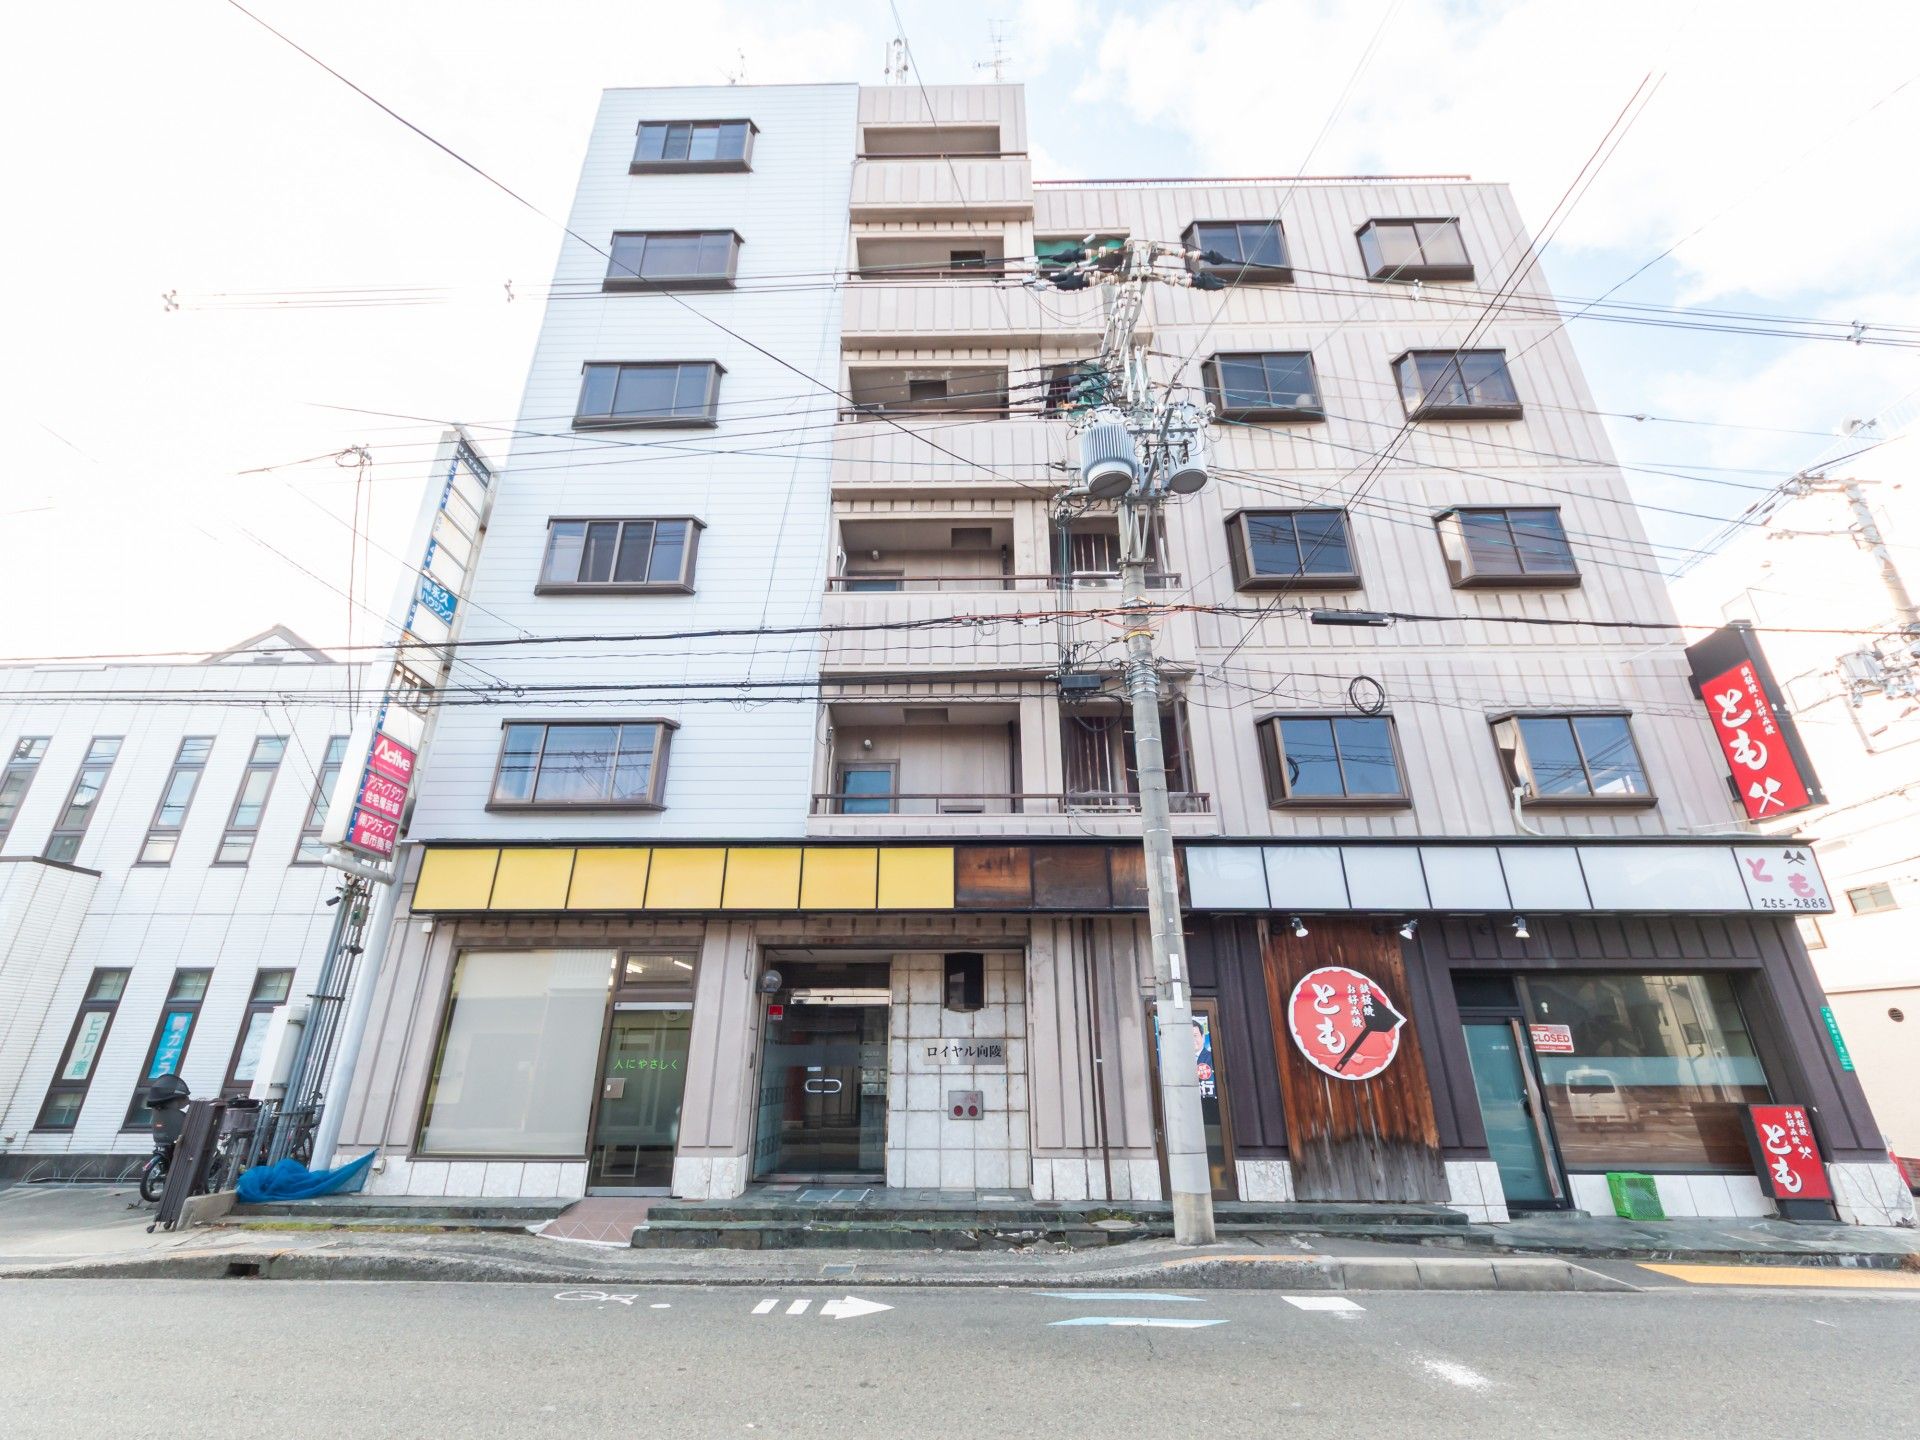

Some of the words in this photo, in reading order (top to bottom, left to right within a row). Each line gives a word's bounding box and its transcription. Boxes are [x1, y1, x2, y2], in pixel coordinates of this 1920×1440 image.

[1714, 688, 1768, 770] とも
[375, 739, 411, 771] Active
[1761, 898, 1827, 909] 255-2888
[1311, 983, 1346, 1054] とも
[1532, 1033, 1570, 1043] CLOSED
[927, 1045, 1002, 1058] ロイヤル向陵
[614, 1059, 678, 1070] 人にやさしく
[1761, 1123, 1802, 1193] とも
